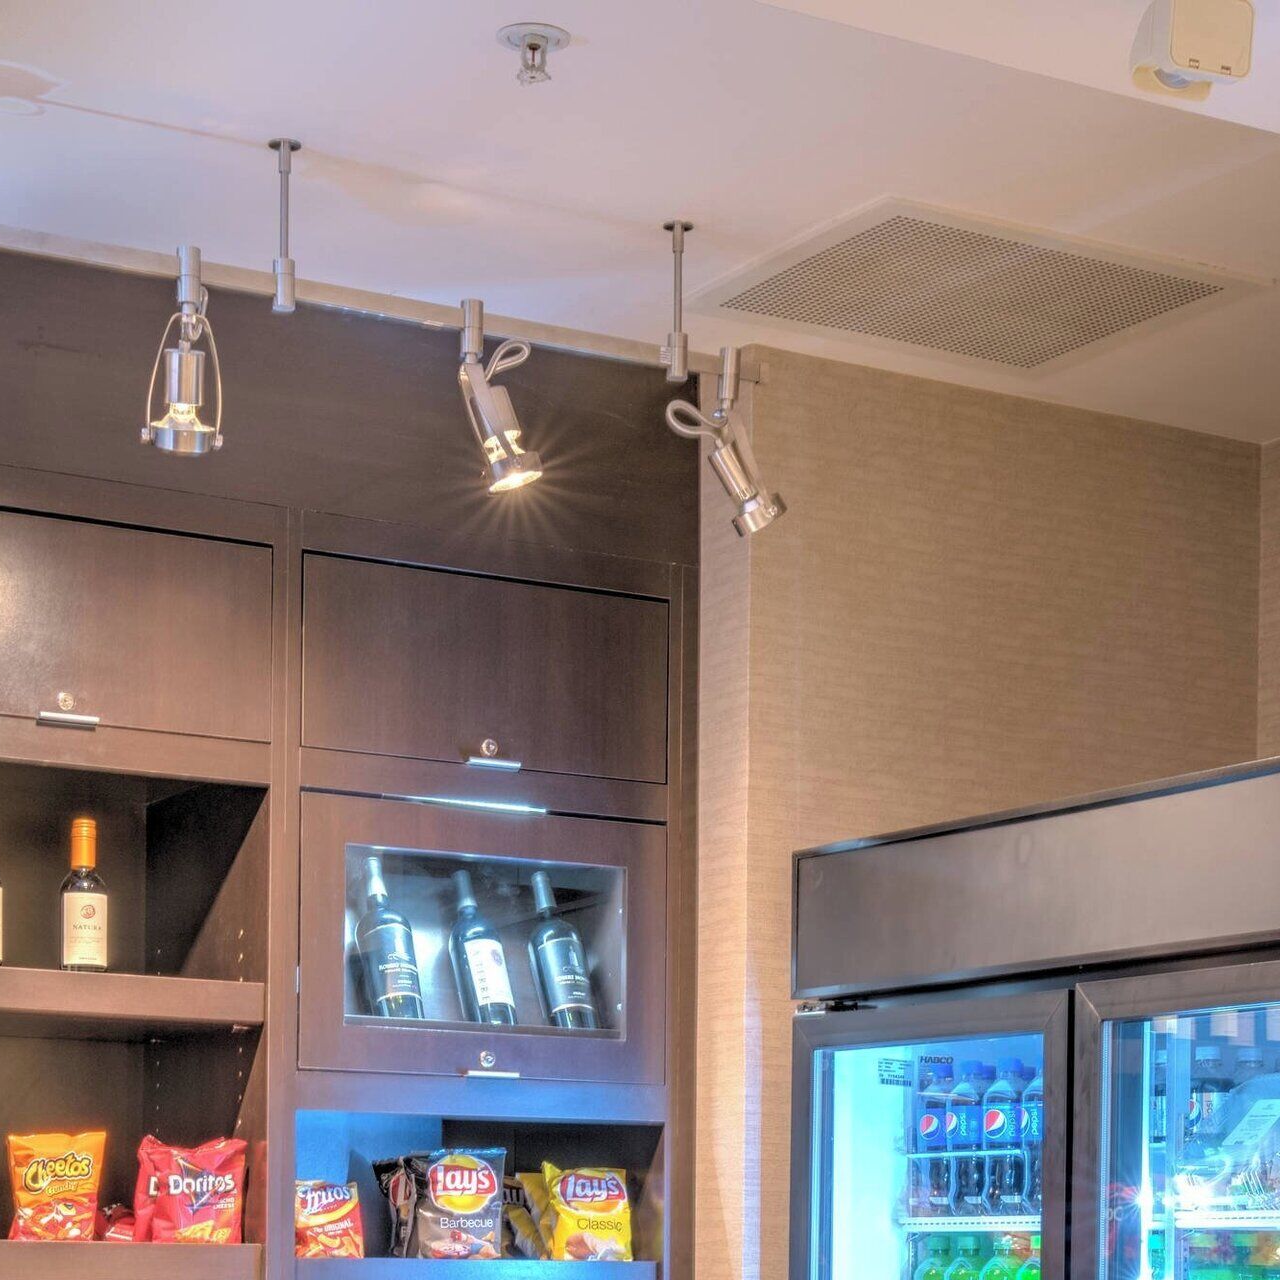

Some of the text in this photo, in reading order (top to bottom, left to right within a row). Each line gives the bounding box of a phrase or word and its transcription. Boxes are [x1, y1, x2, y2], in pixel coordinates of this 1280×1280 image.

[920, 1056, 953, 1064] HABCO
[24, 1152, 92, 1193] Cheetos
[168, 1173, 235, 1195] Doritos
[297, 1185, 350, 1214] Fritos
[440, 1218, 494, 1229] Barbecue
[577, 1218, 623, 1232] Classic
